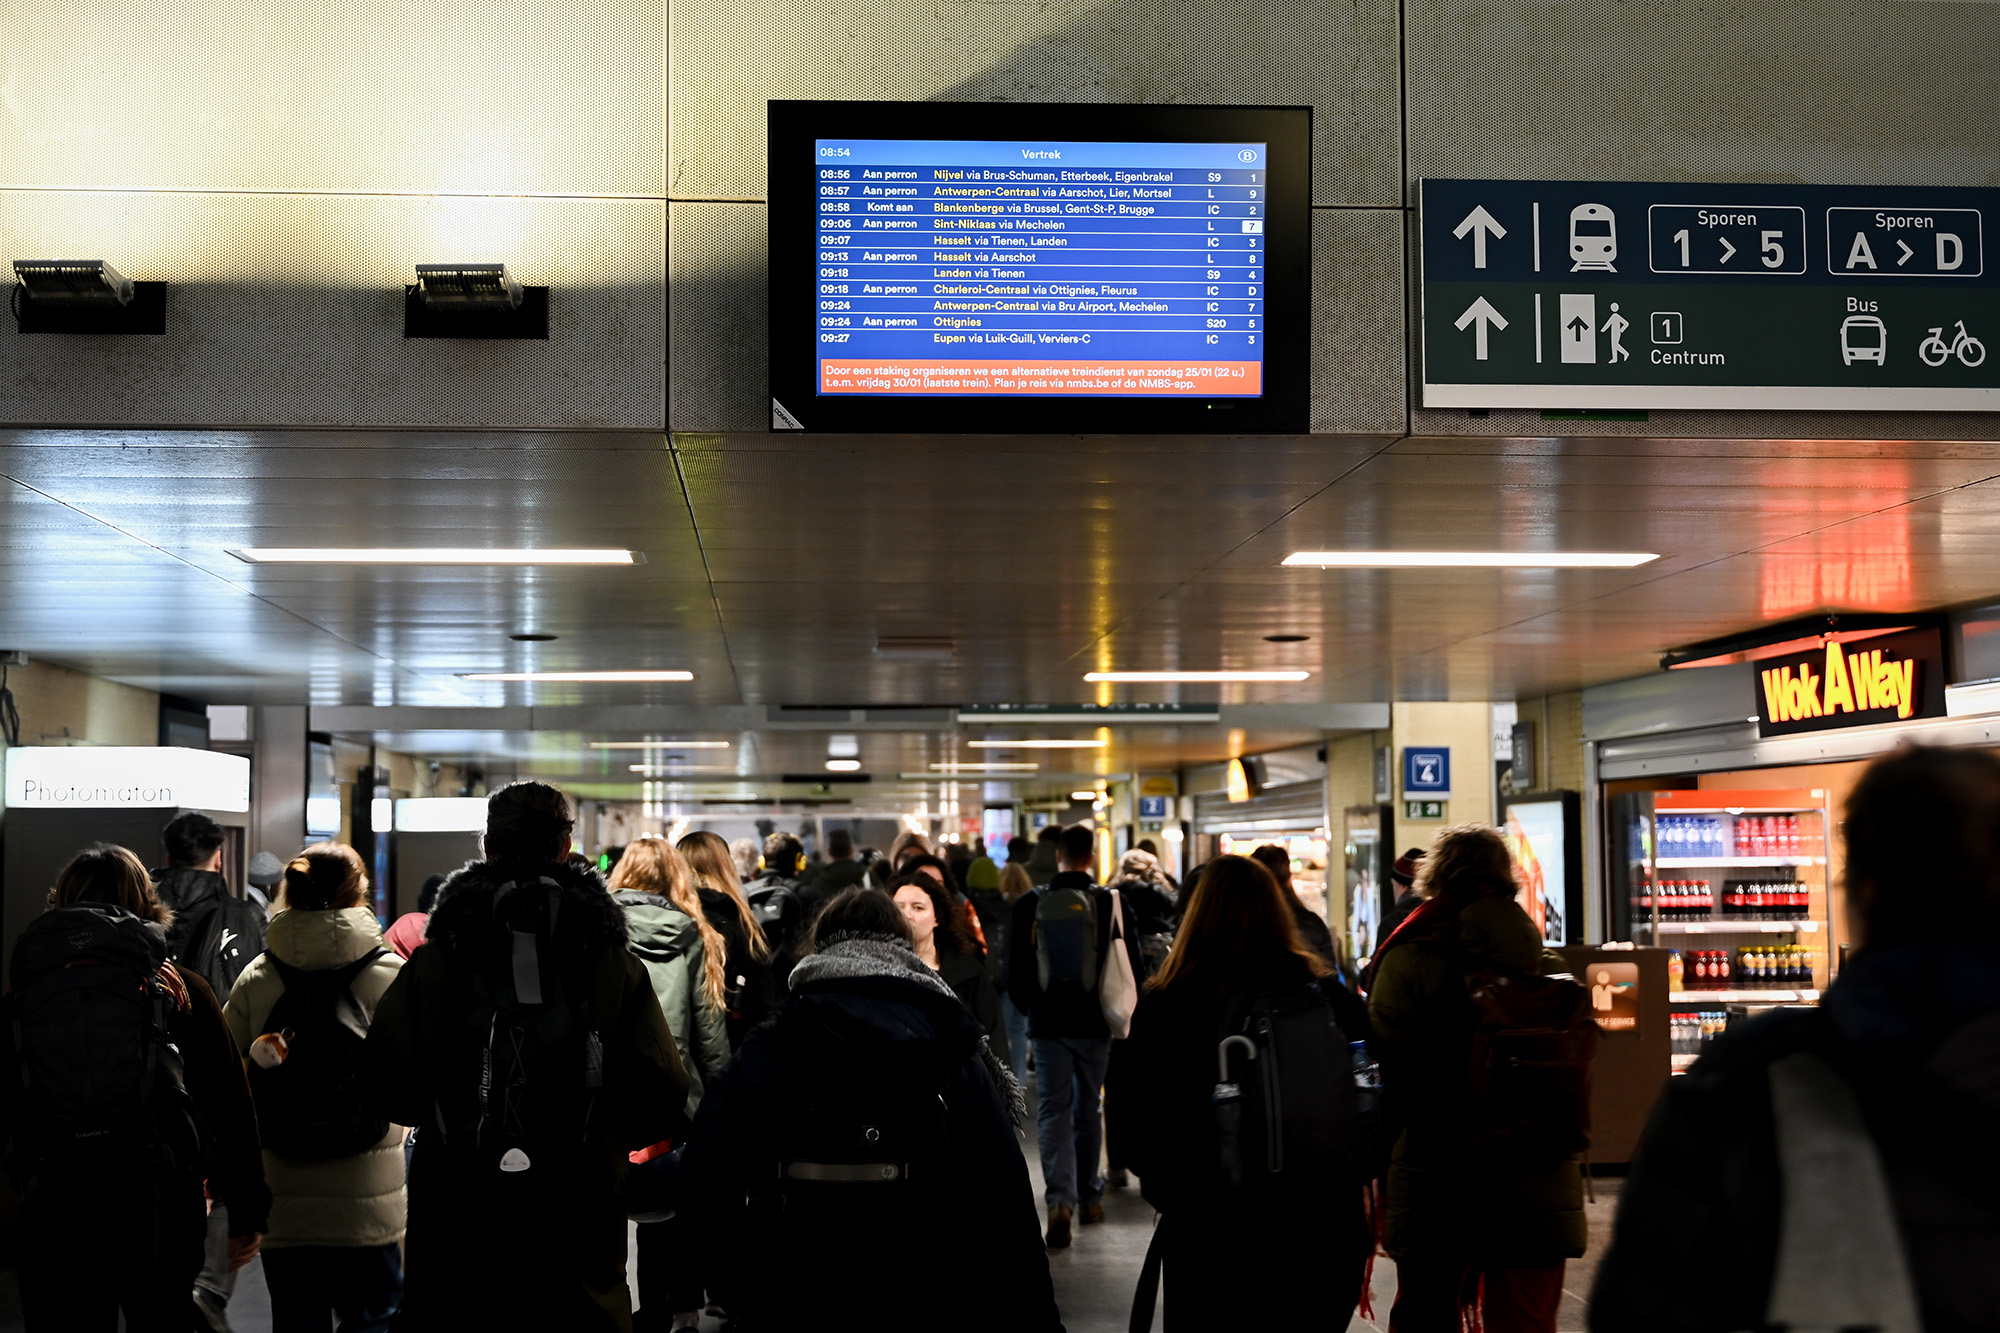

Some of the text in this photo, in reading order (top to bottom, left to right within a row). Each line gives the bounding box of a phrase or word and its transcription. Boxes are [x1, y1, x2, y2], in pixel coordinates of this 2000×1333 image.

[819, 147, 851, 157] 08:54
[1021, 149, 1061, 160] Vertrek
[819, 169, 1256, 184] 08:56 Aan perron Nijvel via Brus-Schuman, Etterbeek, Eigenbrakel S9 1
[819, 185, 1257, 199] 08:57 Aan perron Antwerpen-Centraal via Aarschot, Lier, Mortsel L 9
[819, 201, 1257, 217] 08:58 Komt aan Blankenberge via Brussel, Gent-St-P, Brugge IC 2
[819, 218, 1256, 232] 09:06 Aan perron Sint-Niklaas via Mechelen L 7
[1697, 209, 1758, 229] Sporen
[1875, 212, 1935, 232] Sporen
[820, 235, 1257, 248] 09:07 Hasselt via Tienen, Landen IC 3
[1673, 229, 1785, 269] 1 5
[1845, 231, 1964, 271] A D
[820, 251, 1257, 264] 09:13 Aan perron Hasselt via Aarschot L 8
[820, 267, 1257, 280] 09:18 Landen via Tienen S9 4
[820, 283, 1257, 298] 09:18 Aan perron Charleroi-Centraal via Ottignies, Fleurus IC D
[820, 300, 1256, 313] 09:24 Antwerpen-Centraal via Bru Airport, Mechelen IC 7
[1846, 297, 1879, 313] Bus
[820, 316, 1256, 329] 09:24 Aan perron Ottignies S20 5
[1661, 319, 1672, 338] 1
[820, 332, 1255, 345] 09:27 Eupen via Luik-Guill, Verviers-C IC 3
[1650, 349, 1725, 366] Centrum
[825, 365, 1245, 378] Door een staking organiseren we een alternatieve treindienst van zondag 25/01 (22 u.)
[825, 378, 1197, 391] t.e.m. vrijdag 30/01 (laatste trein). Plan je reis via nmbs.be of de NMBS-app.
[1761, 640, 1915, 723] Wok A Way
